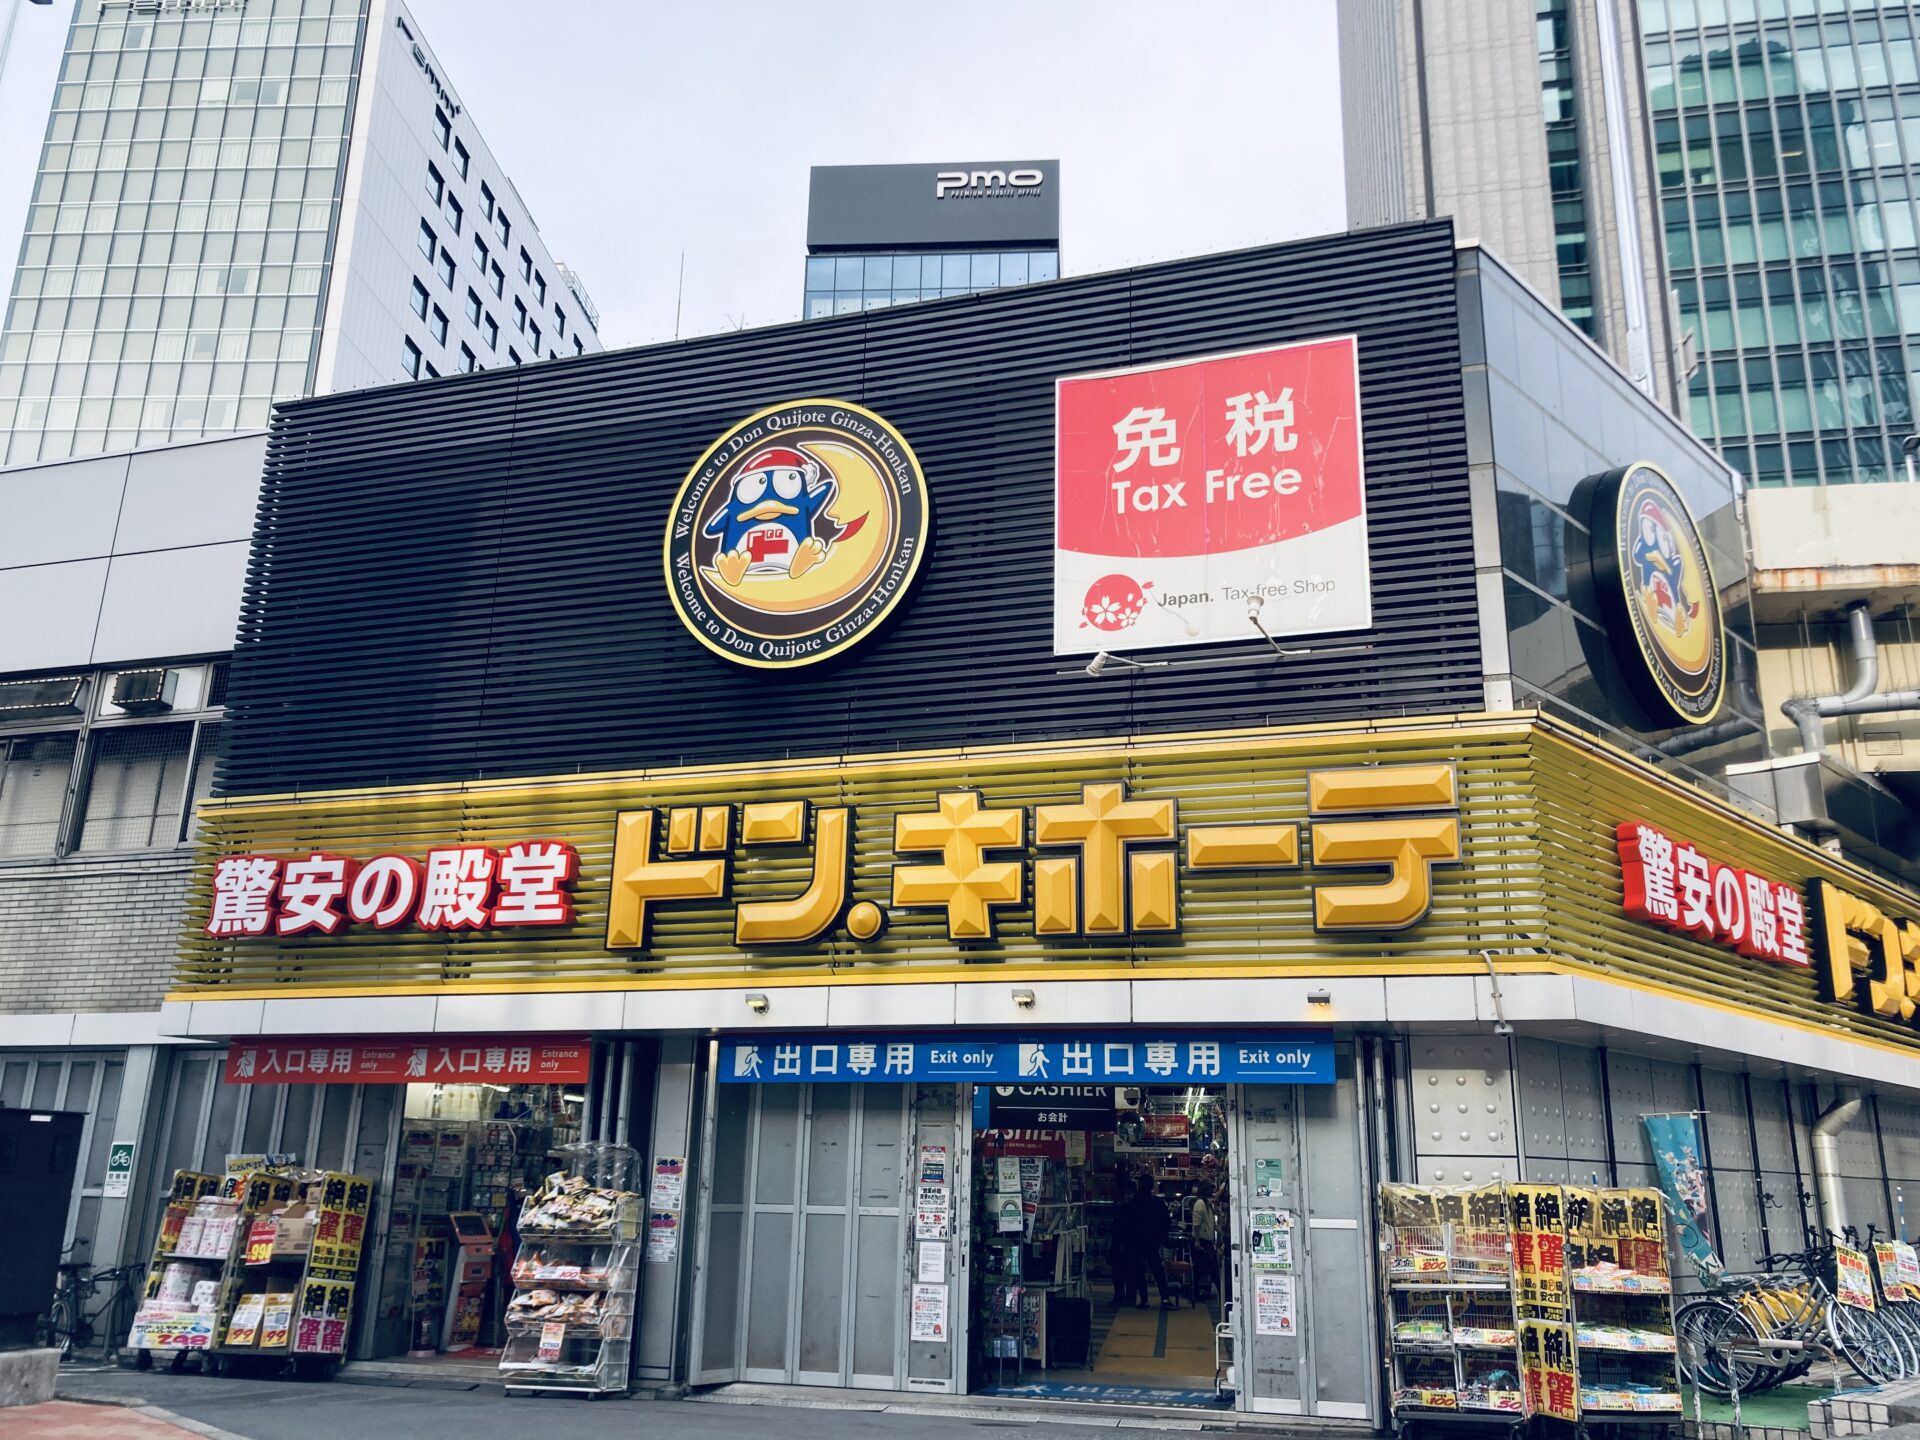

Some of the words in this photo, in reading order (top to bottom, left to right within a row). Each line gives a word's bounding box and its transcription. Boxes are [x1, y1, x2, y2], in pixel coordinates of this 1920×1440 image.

[951, 190, 983, 199] PREMIUM
[1018, 188, 1041, 197] OFFICE
[675, 469, 715, 539] Welcome
[714, 452, 729, 468] to
[728, 427, 763, 452] Don
[766, 410, 826, 431] Quijote
[1112, 480, 1188, 514] Tax
[1206, 468, 1302, 504] Free
[1157, 591, 1214, 609] Japan.
[1222, 583, 1288, 600] Tax-free
[1293, 577, 1336, 597] Shop
[676, 552, 707, 621] Welcome
[706, 619, 719, 635] to
[720, 628, 755, 653] Don
[759, 638, 821, 659] Quijote
[205, 842, 568, 935] 驚安の殿堂
[1637, 825, 1808, 967] 驚安の殿堂
[261, 1047, 351, 1074] 入口専用
[361, 1050, 396, 1060] Entrance
[433, 1047, 532, 1074] 入口専用
[541, 1049, 579, 1059] Entrance
[773, 1042, 914, 1076] 出口専用
[930, 1050, 958, 1064] Exit
[963, 1049, 994, 1068] only
[1062, 1041, 1220, 1076] 出口専用
[1239, 1049, 1270, 1064] Exit
[1275, 1048, 1311, 1068] only
[360, 1061, 378, 1071] only
[540, 1060, 559, 1070] only
[1038, 1112, 1068, 1123] お会計
[1423, 1261, 1448, 1271] 200
[233, 1328, 254, 1340] 99
[266, 1330, 287, 1341] 99
